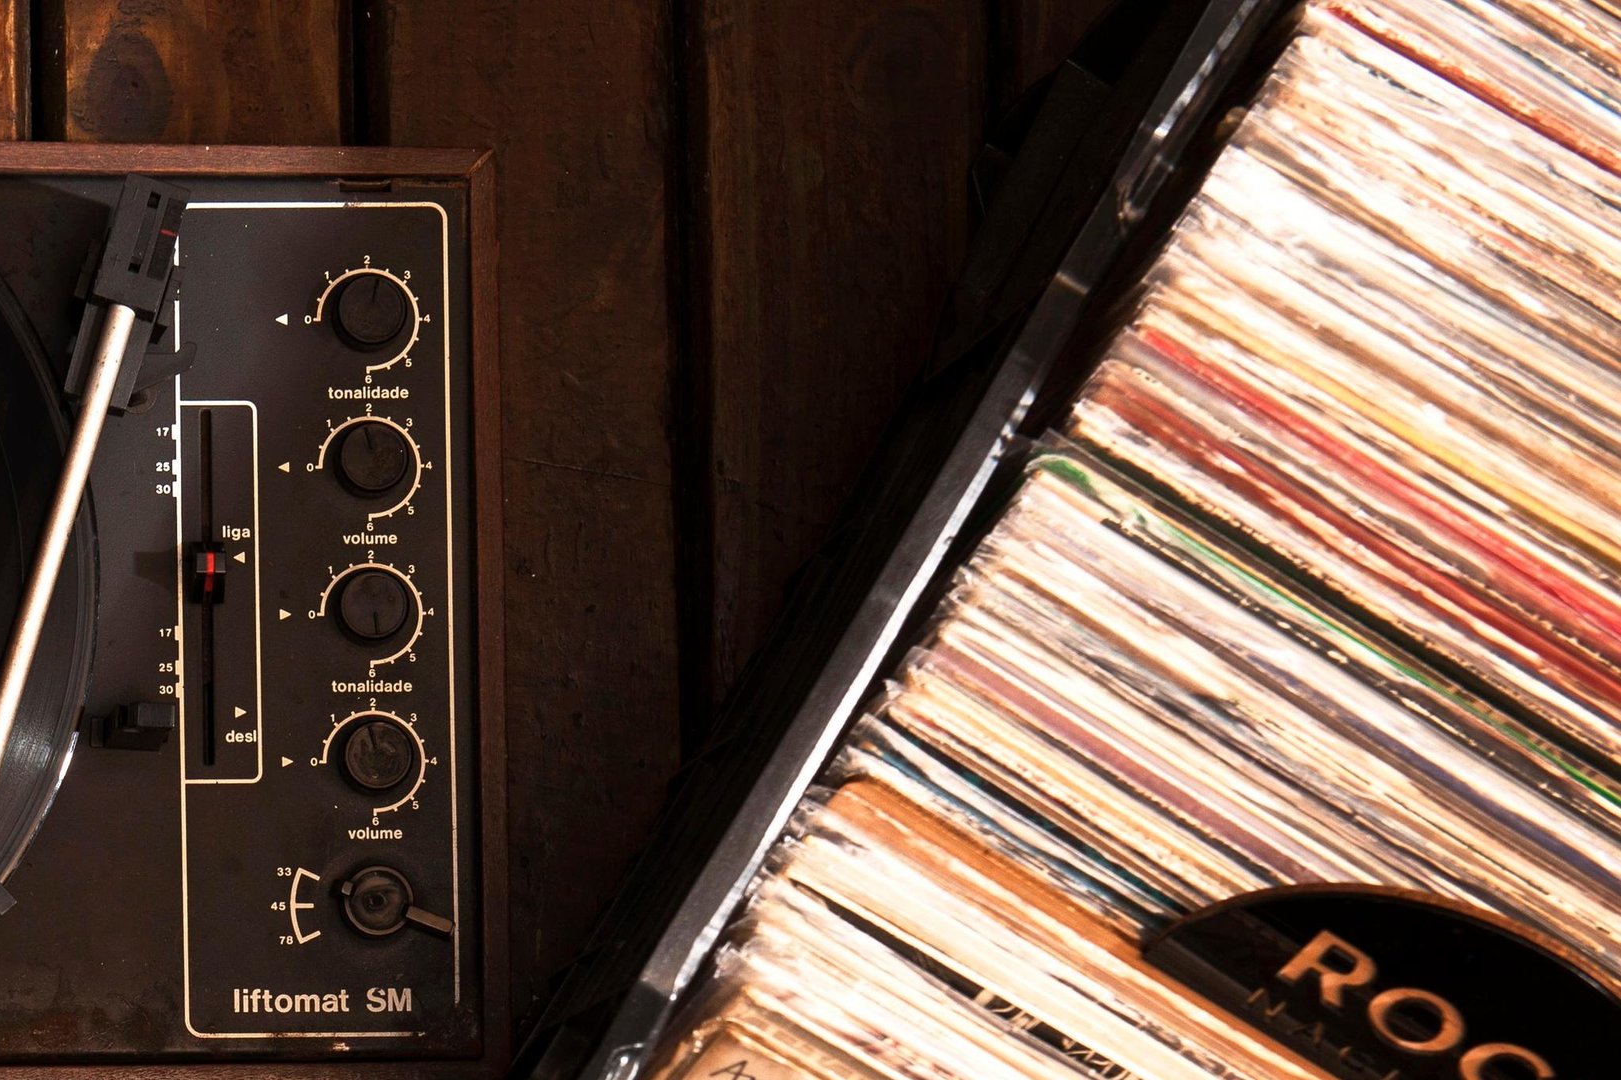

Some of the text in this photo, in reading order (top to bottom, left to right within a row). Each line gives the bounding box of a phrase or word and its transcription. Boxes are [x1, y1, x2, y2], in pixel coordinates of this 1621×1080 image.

[364, 255, 370, 264] 2
[325, 271, 330, 279] 1
[404, 271, 410, 279] 3
[305, 315, 311, 324] 0
[406, 359, 412, 367] 5
[365, 375, 372, 383] 6
[328, 386, 408, 399] tonalidade
[366, 403, 372, 411] 2
[326, 419, 331, 427] 1
[406, 418, 412, 426] 3
[157, 427, 169, 436] 17
[156, 462, 170, 471] 25
[307, 463, 313, 471] 0
[156, 485, 171, 494] 30
[408, 506, 414, 515] 5
[367, 523, 373, 531] 6
[223, 526, 250, 540] liga
[343, 532, 397, 544] volume
[368, 550, 374, 558] 2
[328, 566, 332, 574] 1
[409, 565, 415, 573] 3
[309, 610, 315, 619] 0
[428, 608, 434, 616] 4
[160, 629, 171, 637] 17
[410, 653, 416, 662] 5
[159, 663, 173, 672] 25
[369, 669, 375, 677] 6
[160, 686, 173, 694] 30
[332, 680, 412, 692] tonalidade
[370, 698, 376, 706] 2
[330, 714, 335, 722] 1
[410, 713, 417, 723] 3
[226, 730, 256, 742] desl
[311, 758, 317, 766] 0
[431, 757, 437, 765] 4
[413, 801, 419, 809] 5
[372, 817, 379, 825] 6
[348, 827, 402, 839] volume
[278, 868, 291, 876] 33
[271, 902, 285, 910] 45
[280, 936, 293, 944] 78
[234, 988, 411, 1013] liftomat SM
